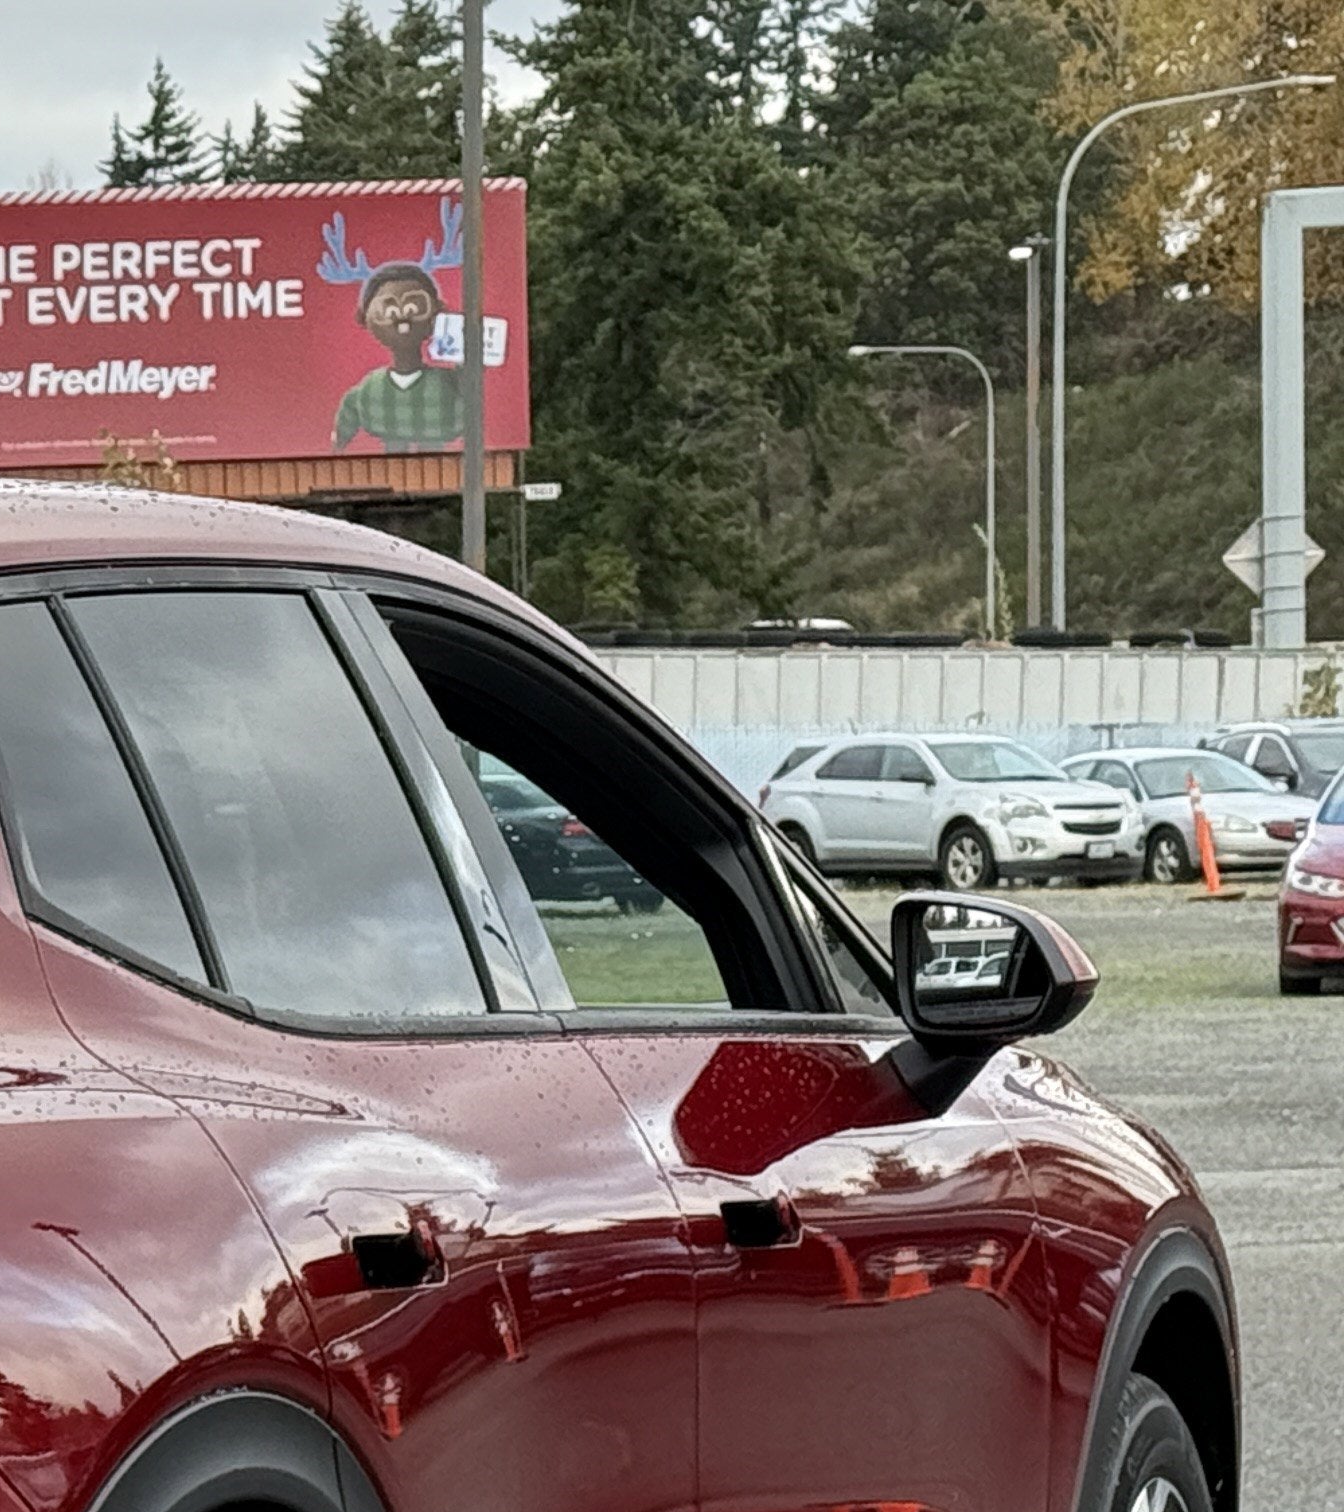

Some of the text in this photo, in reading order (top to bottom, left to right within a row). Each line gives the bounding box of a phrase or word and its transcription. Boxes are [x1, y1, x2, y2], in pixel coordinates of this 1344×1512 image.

[53, 238, 262, 281] PERFECT
[28, 283, 180, 325] EVERY
[192, 279, 305, 320] TIME
